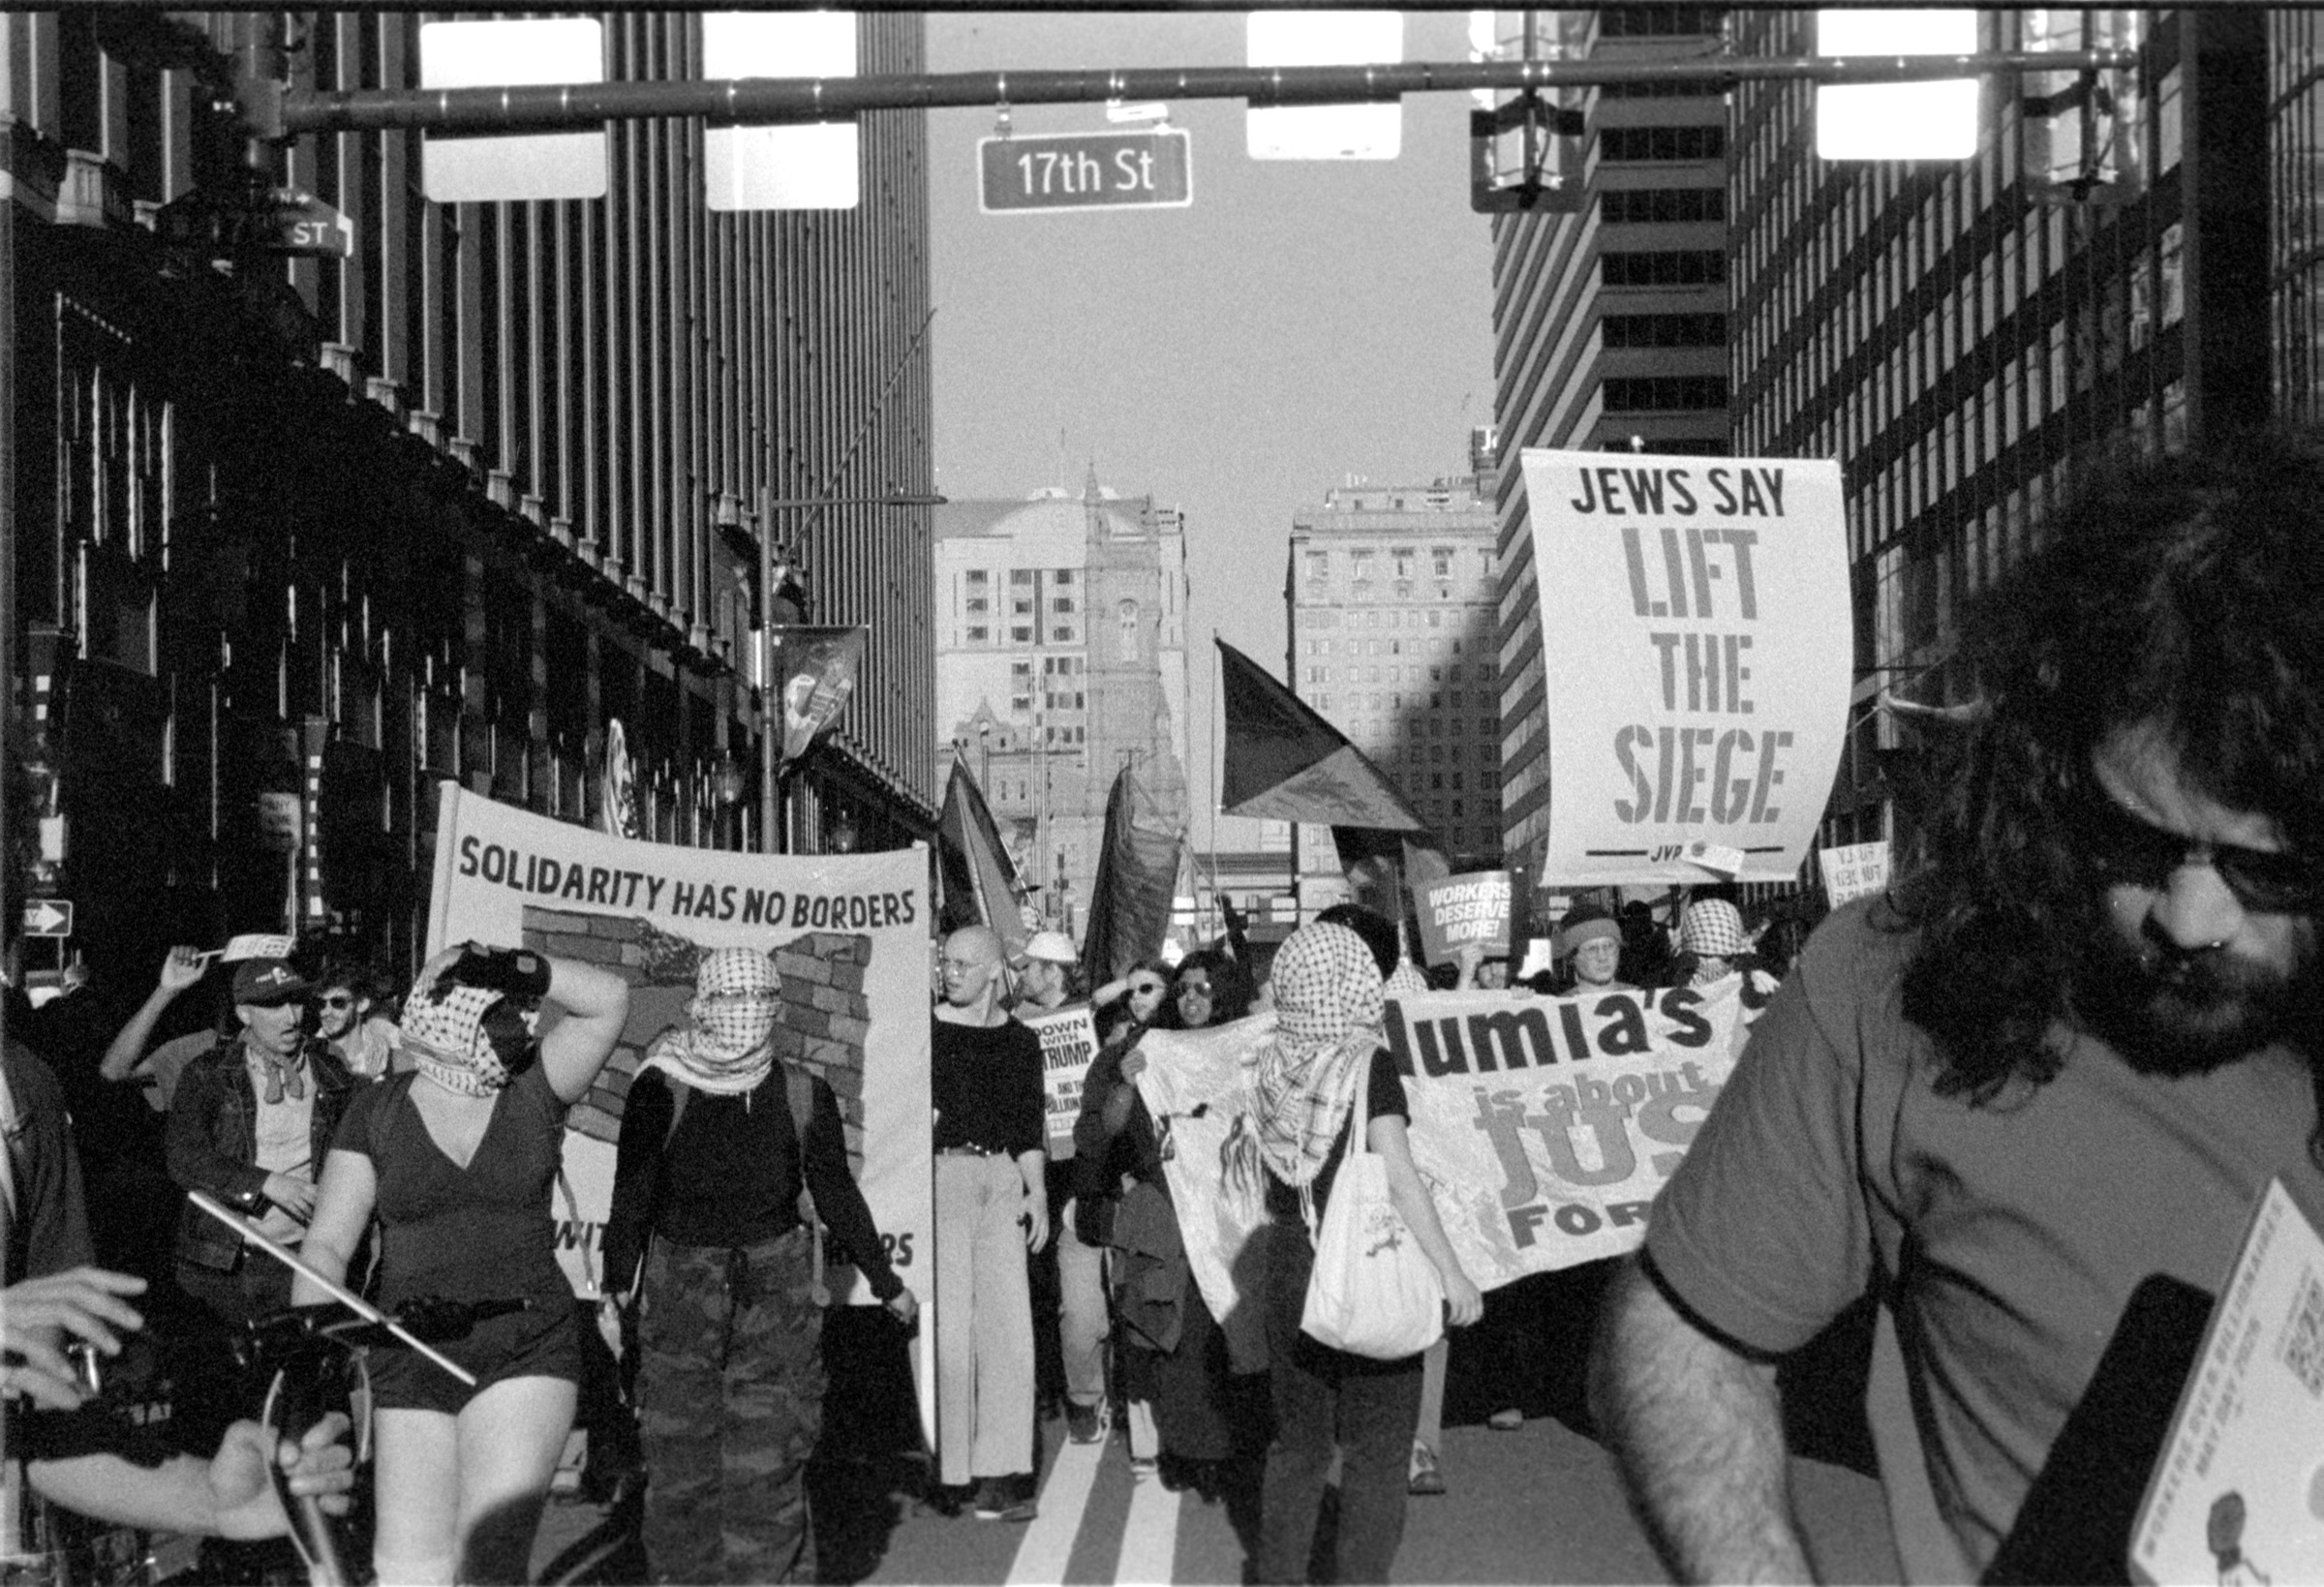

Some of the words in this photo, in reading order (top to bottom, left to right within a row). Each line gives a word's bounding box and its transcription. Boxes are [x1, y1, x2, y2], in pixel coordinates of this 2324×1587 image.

[1018, 150, 1101, 195] 17th
[1115, 147, 1155, 191] St
[293, 221, 328, 245] ST
[1572, 467, 1697, 518] JEWS
[1707, 467, 1785, 518] SAY
[1621, 527, 1758, 620] LIFT
[1650, 632, 1754, 715] THE
[1614, 724, 1794, 826] SIEGE
[459, 834, 665, 910] SOLIDARITY
[672, 880, 738, 922] HAS
[742, 888, 786, 927] NO
[791, 888, 916, 930] BORDERS
[1428, 881, 1512, 908] WORKERS
[1435, 900, 1511, 927] DESERVE
[1446, 920, 1500, 943] MORE!
[1043, 1032, 1079, 1047] WITH
[1043, 1041, 1091, 1071] TRUMP
